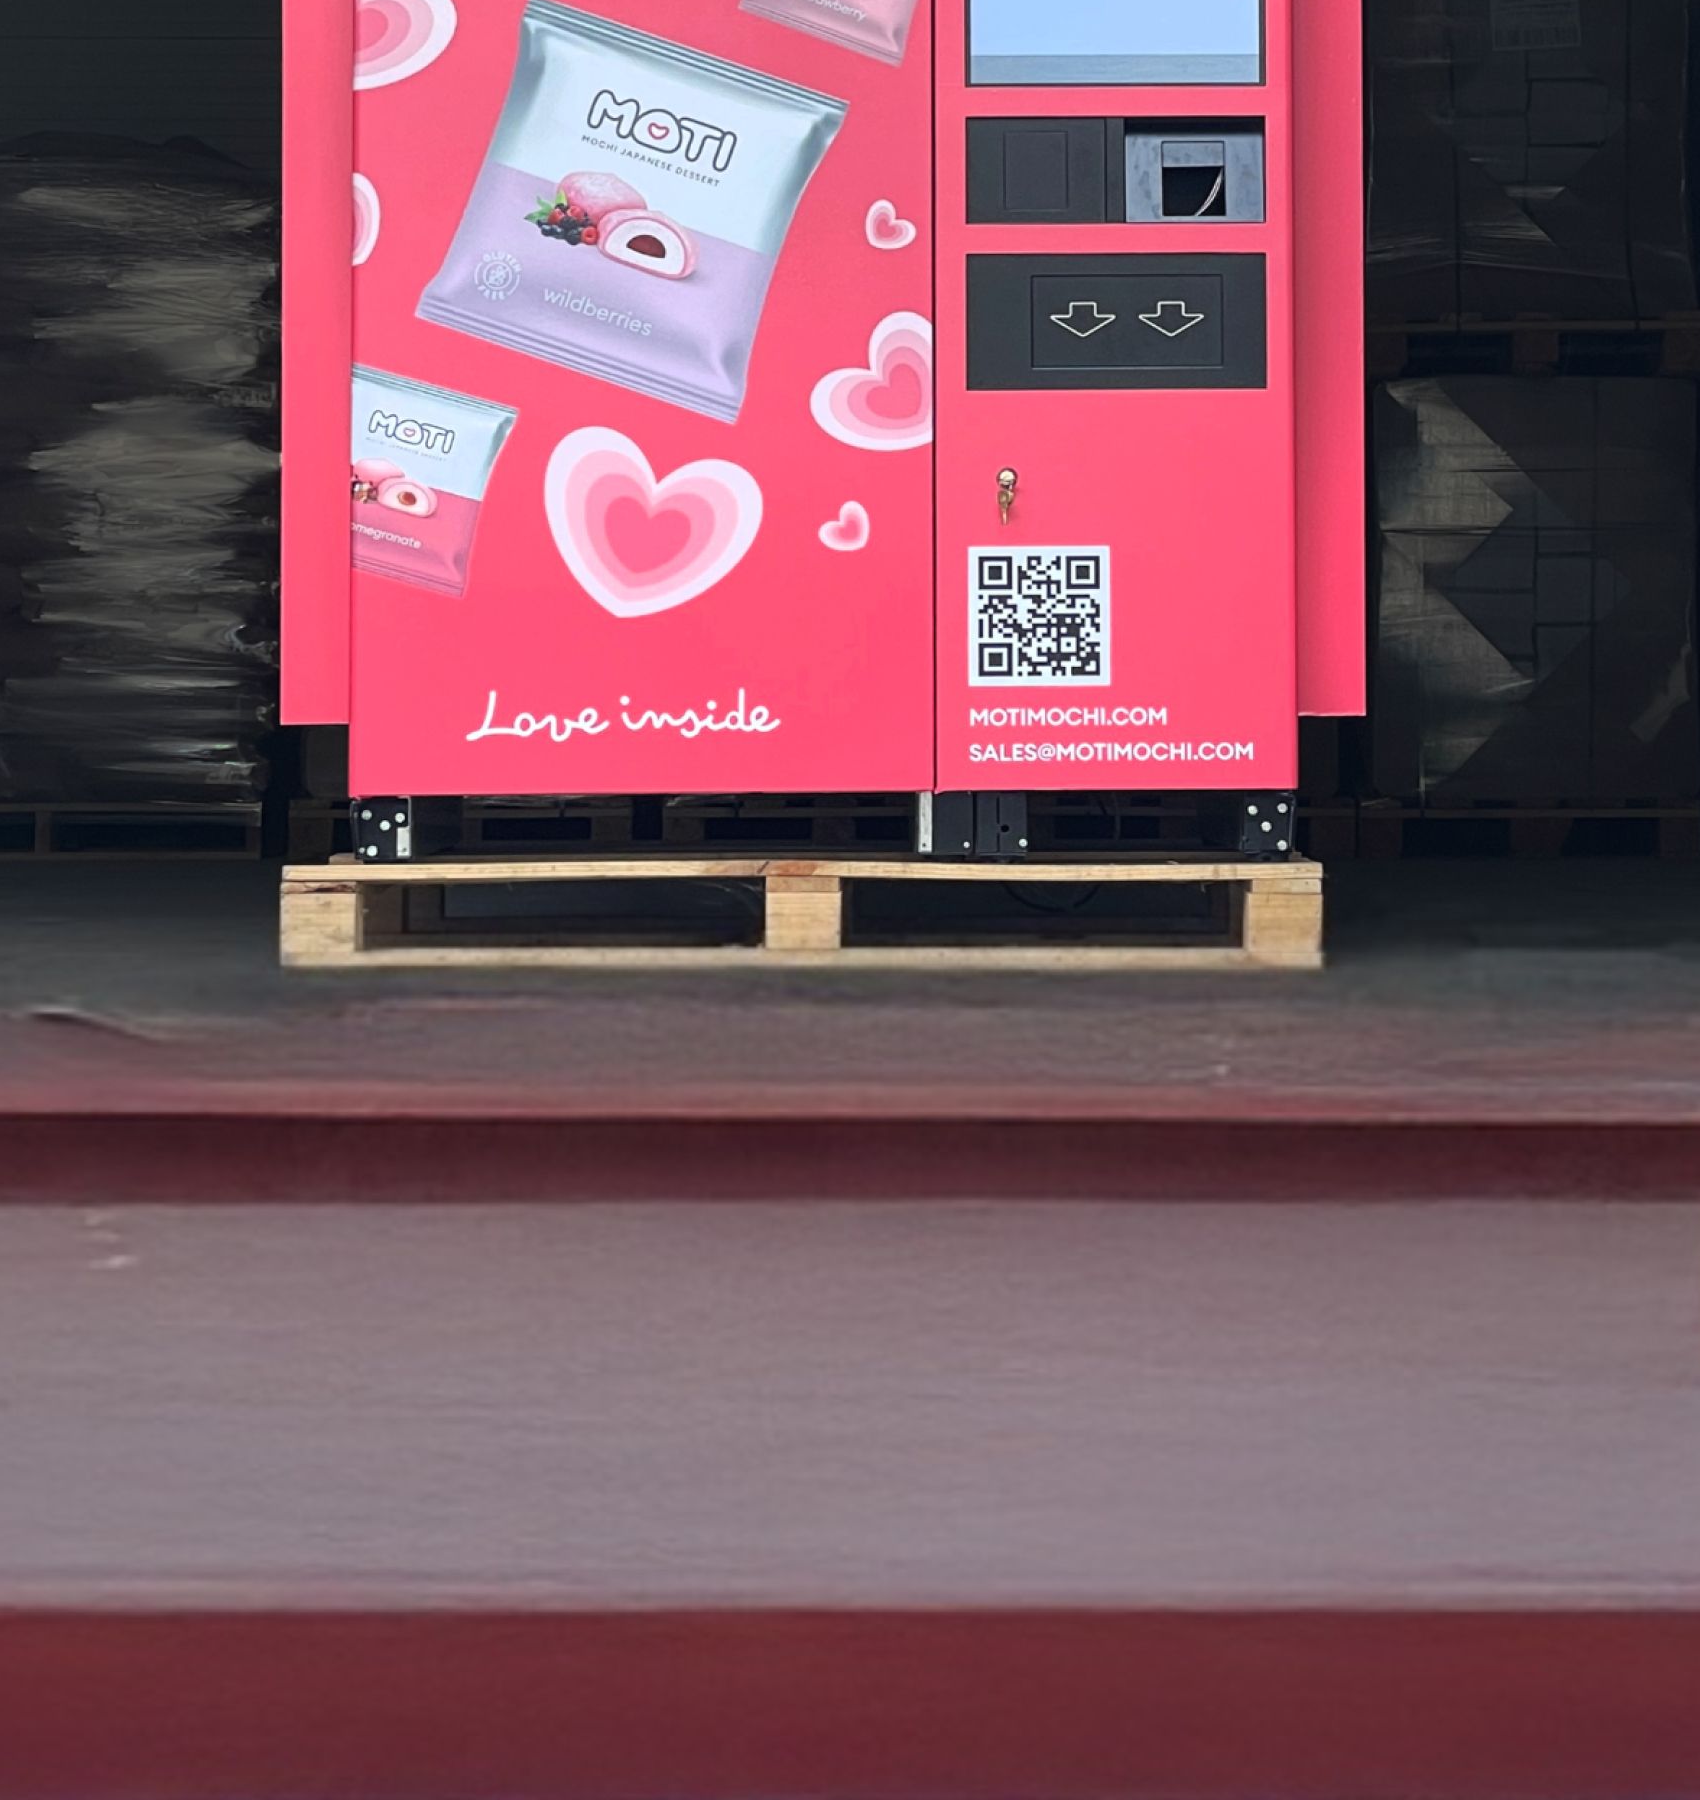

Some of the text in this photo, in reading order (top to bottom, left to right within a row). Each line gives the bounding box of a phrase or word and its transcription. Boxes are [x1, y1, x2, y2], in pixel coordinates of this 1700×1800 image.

[587, 89, 737, 171] MOTI
[581, 134, 720, 187] MOCHI JAPANESE DESSERT
[543, 287, 652, 337] wildberries
[368, 409, 455, 454] MOTI
[465, 687, 781, 742] Love inside
[969, 707, 1168, 728] MOTIMOCHI.COM
[968, 741, 1255, 763] SALES@MOTIMOCHI.COM
